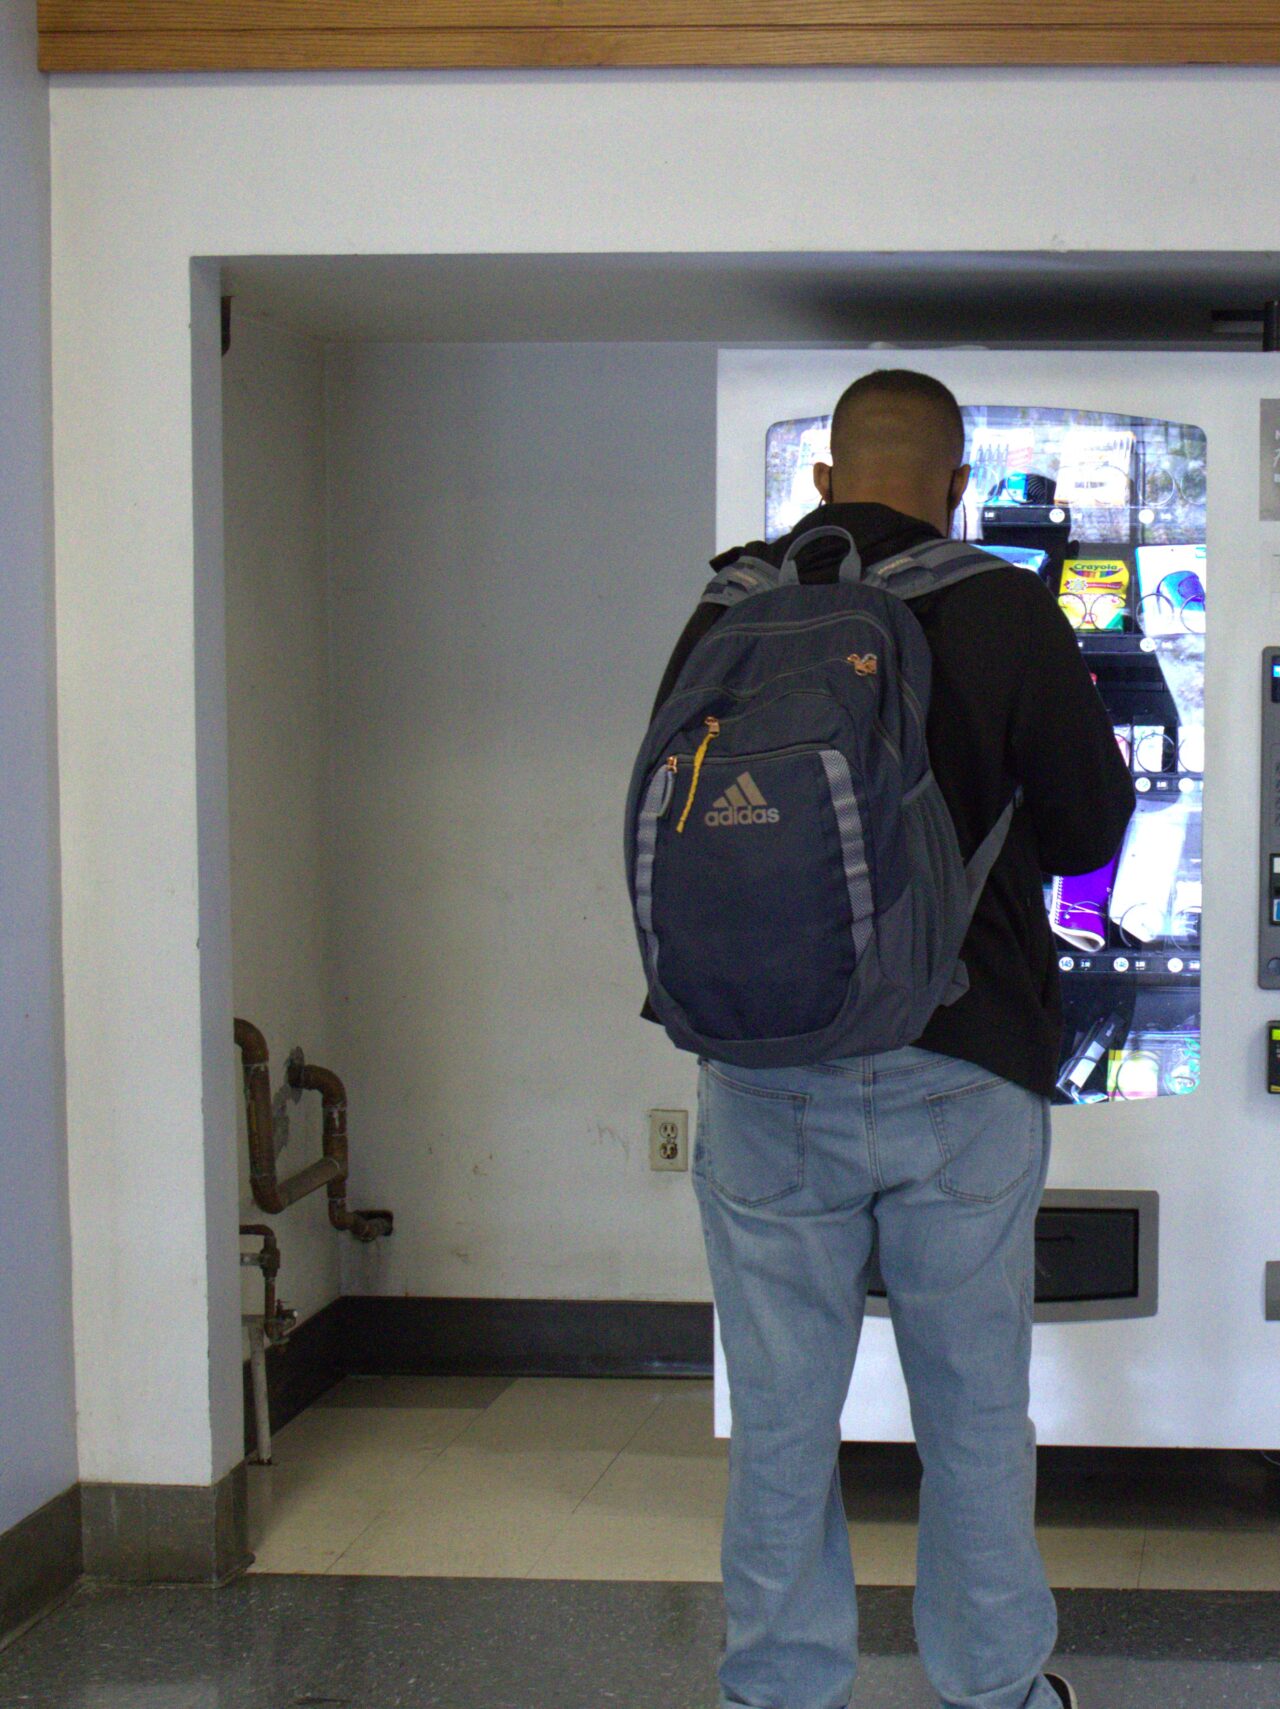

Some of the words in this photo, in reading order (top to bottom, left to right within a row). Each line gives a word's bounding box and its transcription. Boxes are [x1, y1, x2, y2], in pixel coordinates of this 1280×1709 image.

[1073, 563, 1118, 571] Crayola
[704, 805, 781, 827] adidas
[1060, 959, 1072, 968] 145
